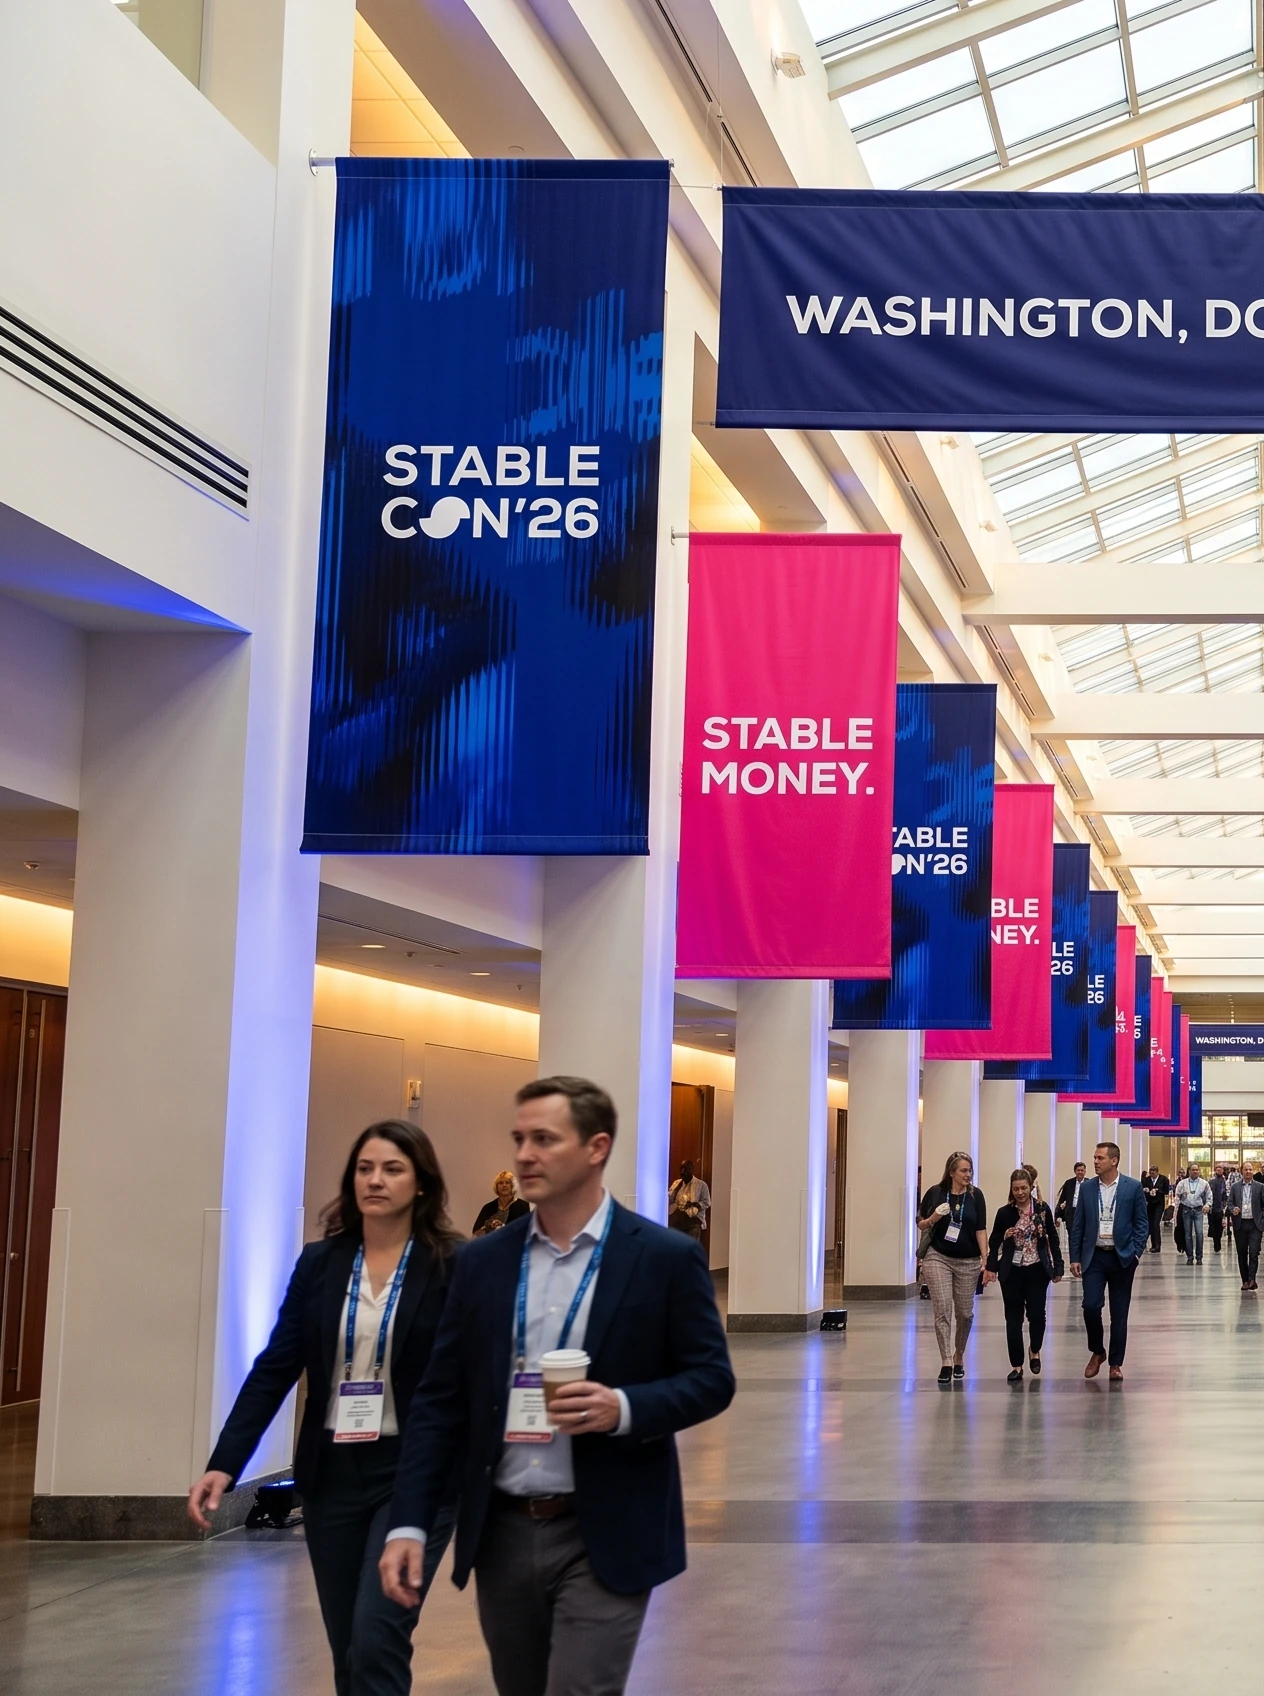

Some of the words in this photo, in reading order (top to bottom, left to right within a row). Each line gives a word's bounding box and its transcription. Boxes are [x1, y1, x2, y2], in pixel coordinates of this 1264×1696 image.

[785, 295, 1188, 344] WASHINGTON,
[382, 444, 600, 487] STABLE
[702, 716, 873, 750] STABLE
[701, 761, 875, 795] MONEY.
[1195, 1036, 1256, 1045] WASHINGTON,
